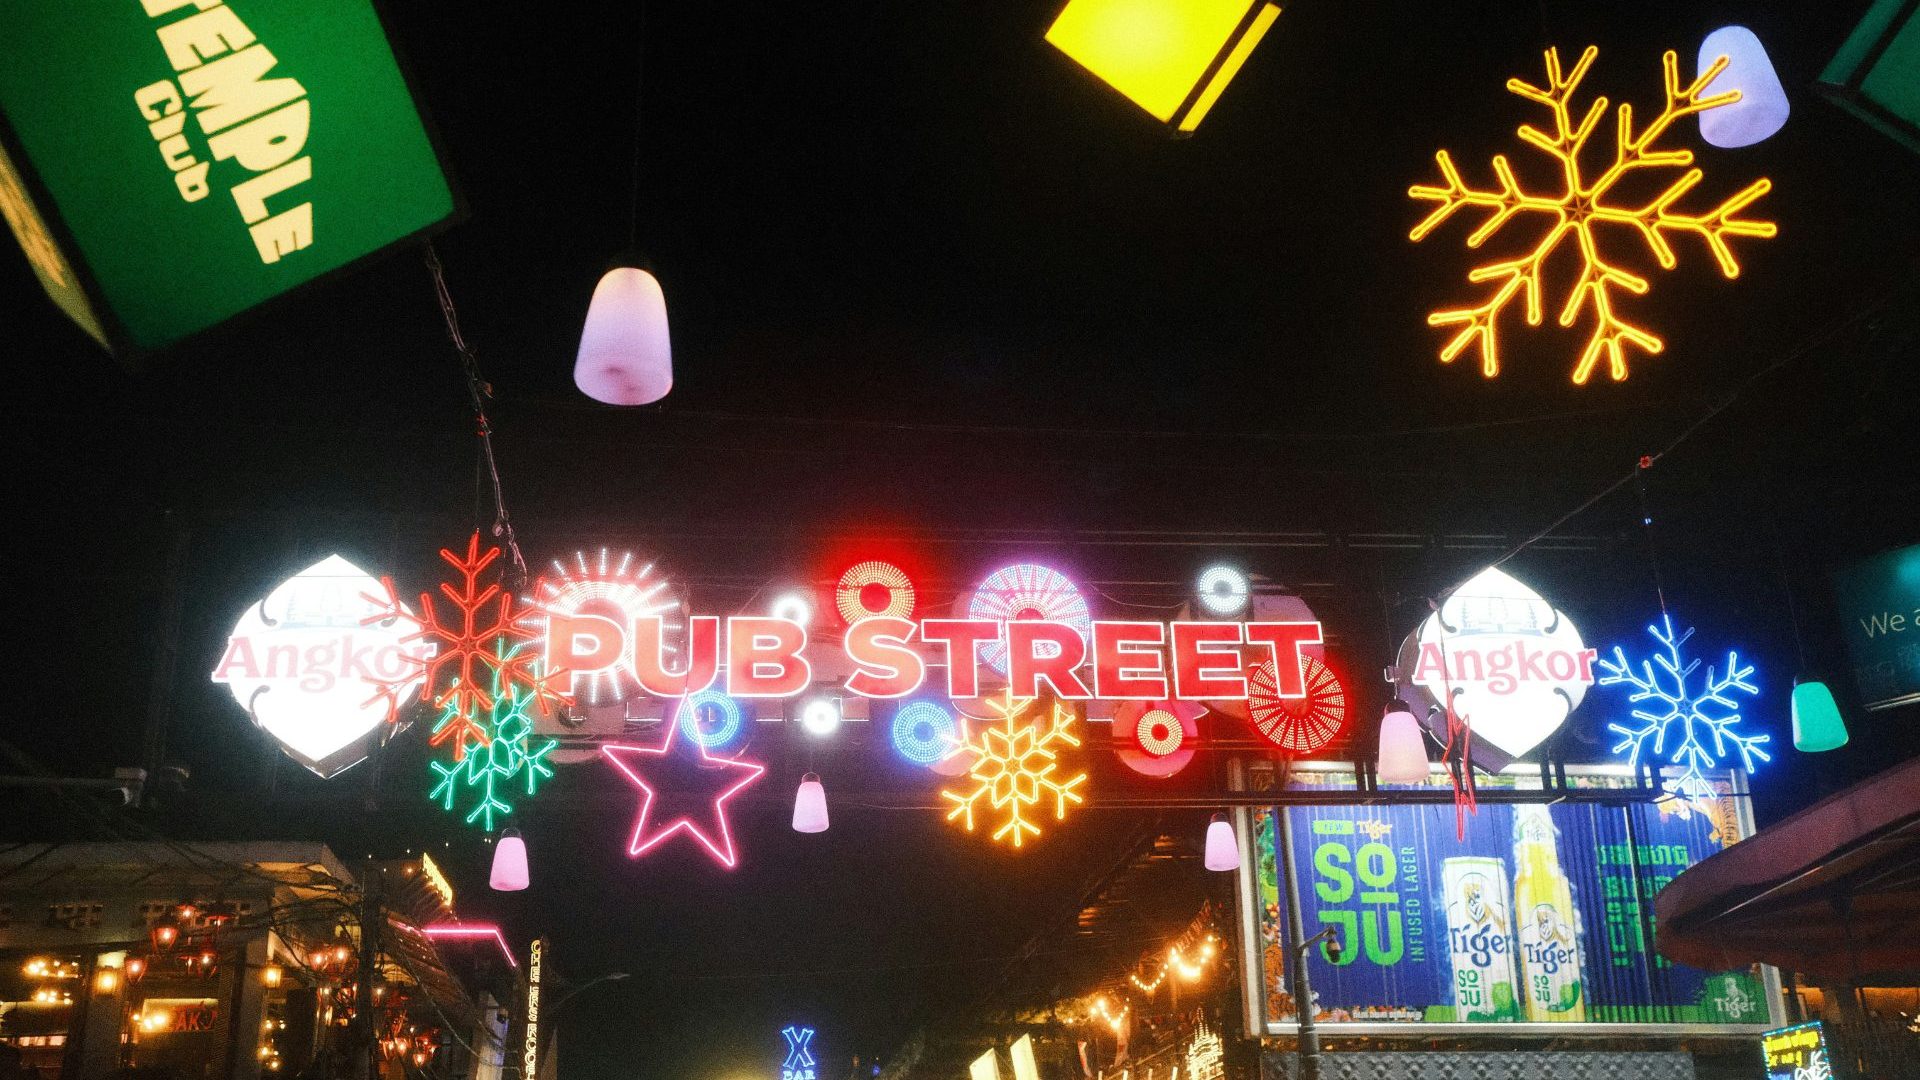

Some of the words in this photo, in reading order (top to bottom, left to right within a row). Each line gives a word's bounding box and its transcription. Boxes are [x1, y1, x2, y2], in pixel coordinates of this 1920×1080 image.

[1860, 611, 1906, 638] We
[215, 635, 434, 693] Angkor
[545, 614, 811, 698] PUB
[843, 614, 1324, 699] STREET
[1414, 640, 1597, 695] Angkor
[1314, 842, 1399, 903] SO
[1402, 846, 1419, 892] LAGER
[1317, 910, 1404, 966] JU
[1405, 898, 1425, 964] INFUSED
[1450, 923, 1513, 967] Tiger
[1523, 941, 1575, 974] Tiger
[1714, 996, 1757, 1019] Tiger
[782, 1026, 815, 1069] X
